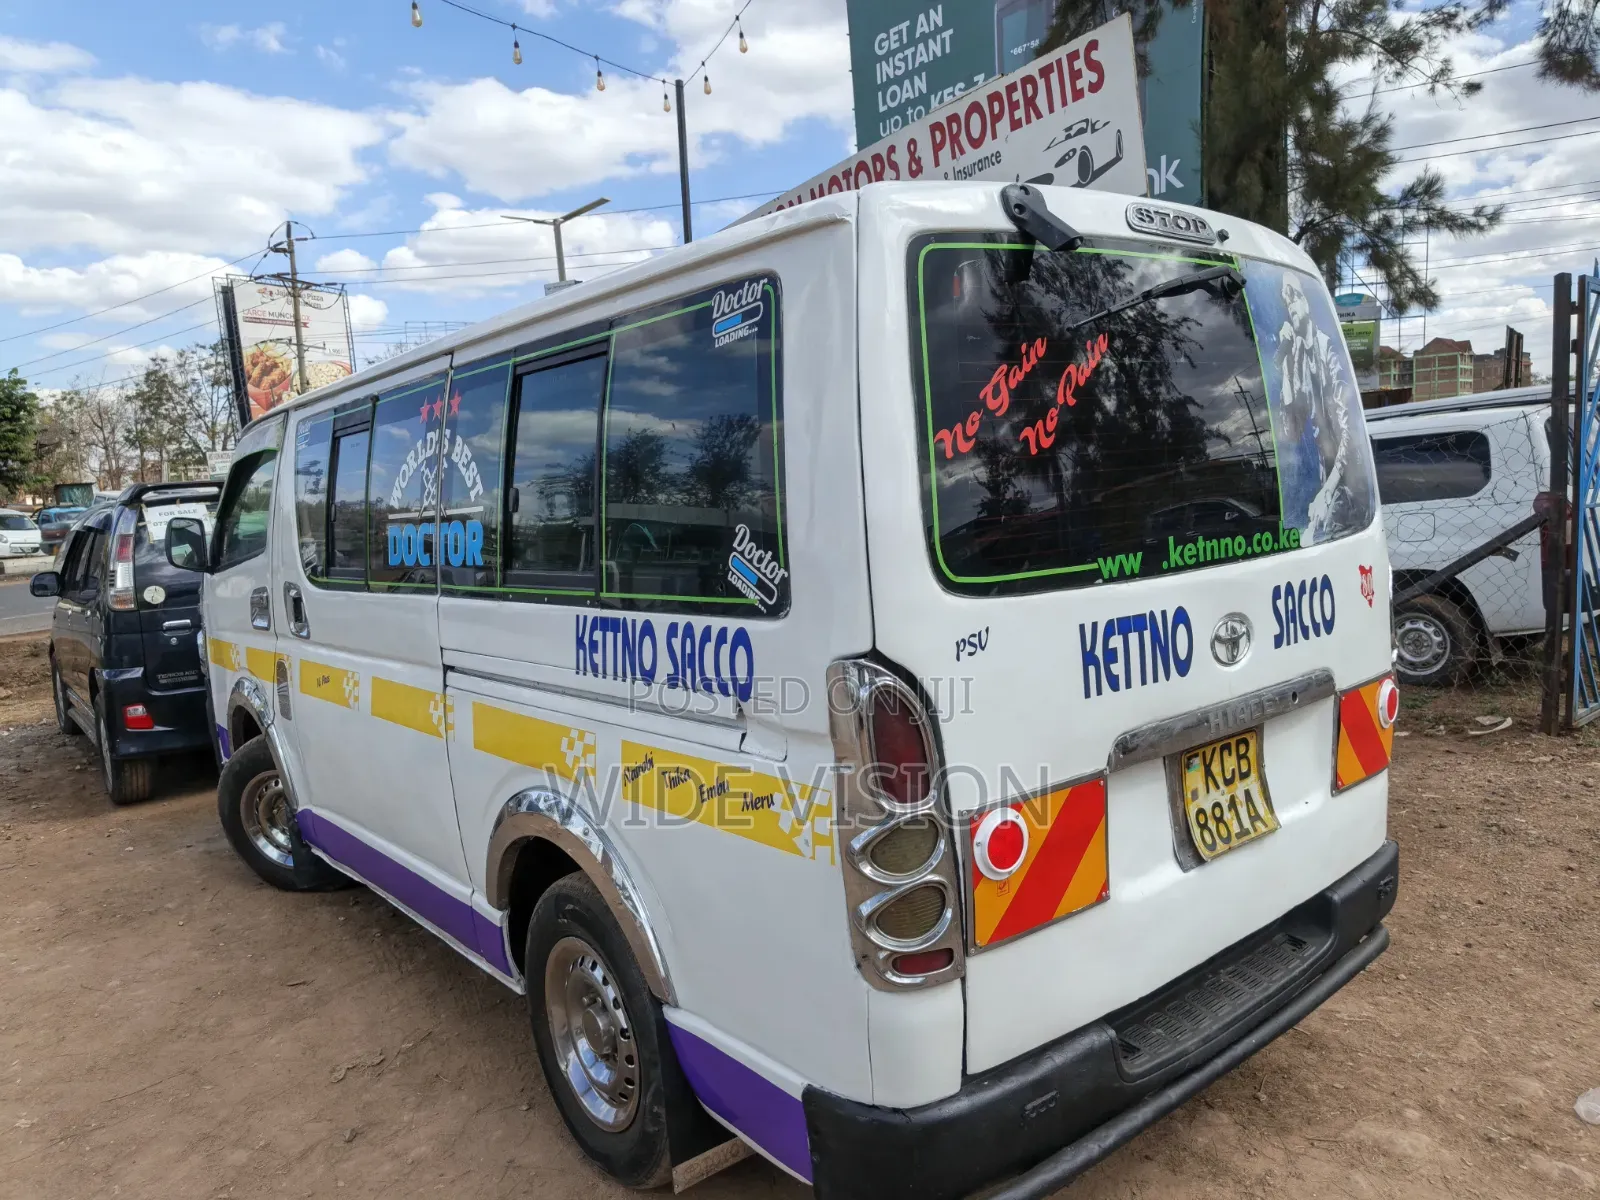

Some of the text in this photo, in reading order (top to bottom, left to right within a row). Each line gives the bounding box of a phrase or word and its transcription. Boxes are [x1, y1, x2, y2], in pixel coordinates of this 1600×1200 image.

[874, 4, 944, 56] GET AN
[875, 28, 954, 85] INSTANT
[877, 71, 927, 113] LOAN
[906, 137, 924, 179] &
[928, 38, 1105, 168] PROPERTIES
[879, 115, 902, 138] up
[906, 105, 926, 122] to
[953, 149, 1003, 181] Insurance
[1134, 206, 1208, 234] STOP
[711, 278, 768, 319] Doctor
[979, 336, 1047, 417] Gain
[1057, 332, 1108, 407] Pain
[390, 428, 484, 510] WORLD'S BEST
[388, 519, 484, 568] DOCTOR
[732, 523, 789, 585] Doctor
[575, 613, 755, 703] KETTNO SACCO
[1079, 573, 1336, 700] KETTNO SACCO
[1208, 693, 1276, 734] HIACE
[623, 751, 775, 813] Nairobi Thika Embu Meru
[1202, 736, 1251, 794] KCB
[1195, 788, 1268, 852] 881A
